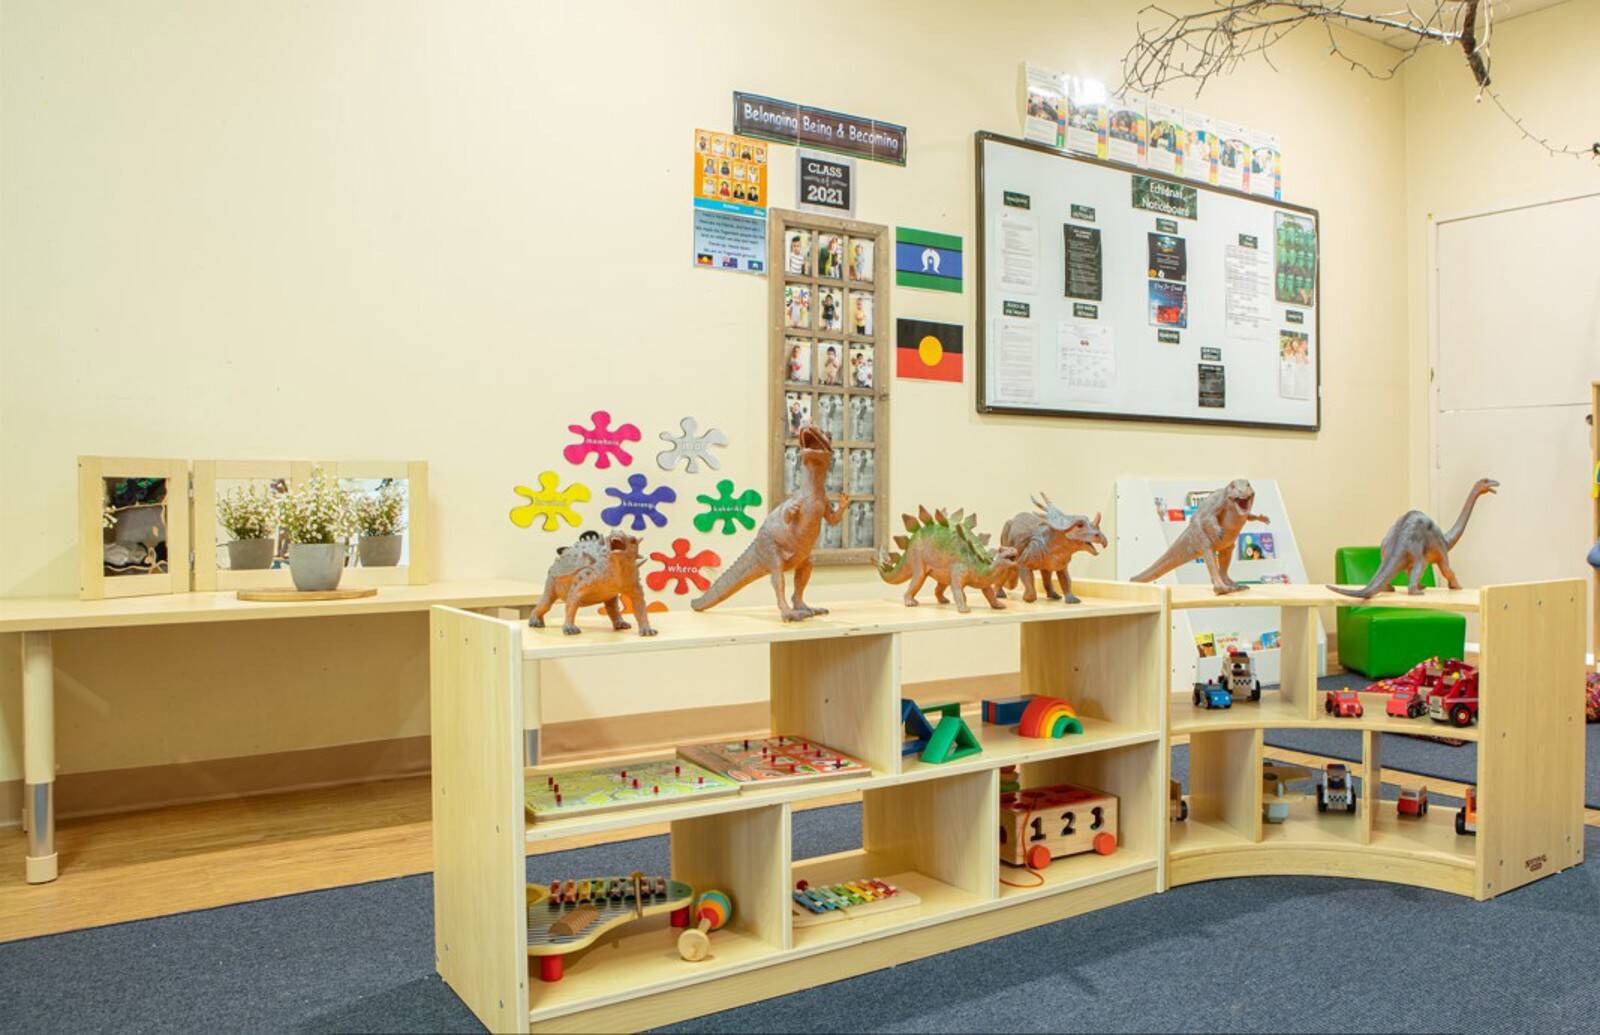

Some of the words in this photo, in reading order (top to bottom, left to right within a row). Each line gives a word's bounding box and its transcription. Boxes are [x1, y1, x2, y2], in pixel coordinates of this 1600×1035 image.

[744, 103, 798, 133] Belonging
[803, 115, 833, 140] Being
[836, 123, 845, 138] &
[849, 125, 898, 153] Becoming
[808, 162, 843, 178] CLASS
[807, 184, 844, 206] 2021
[1142, 197, 1190, 217] Noticeboard
[668, 563, 699, 574] whero
[1030, 817, 1046, 842] 1
[1061, 811, 1076, 836] 2
[1090, 806, 1105, 830] 3
